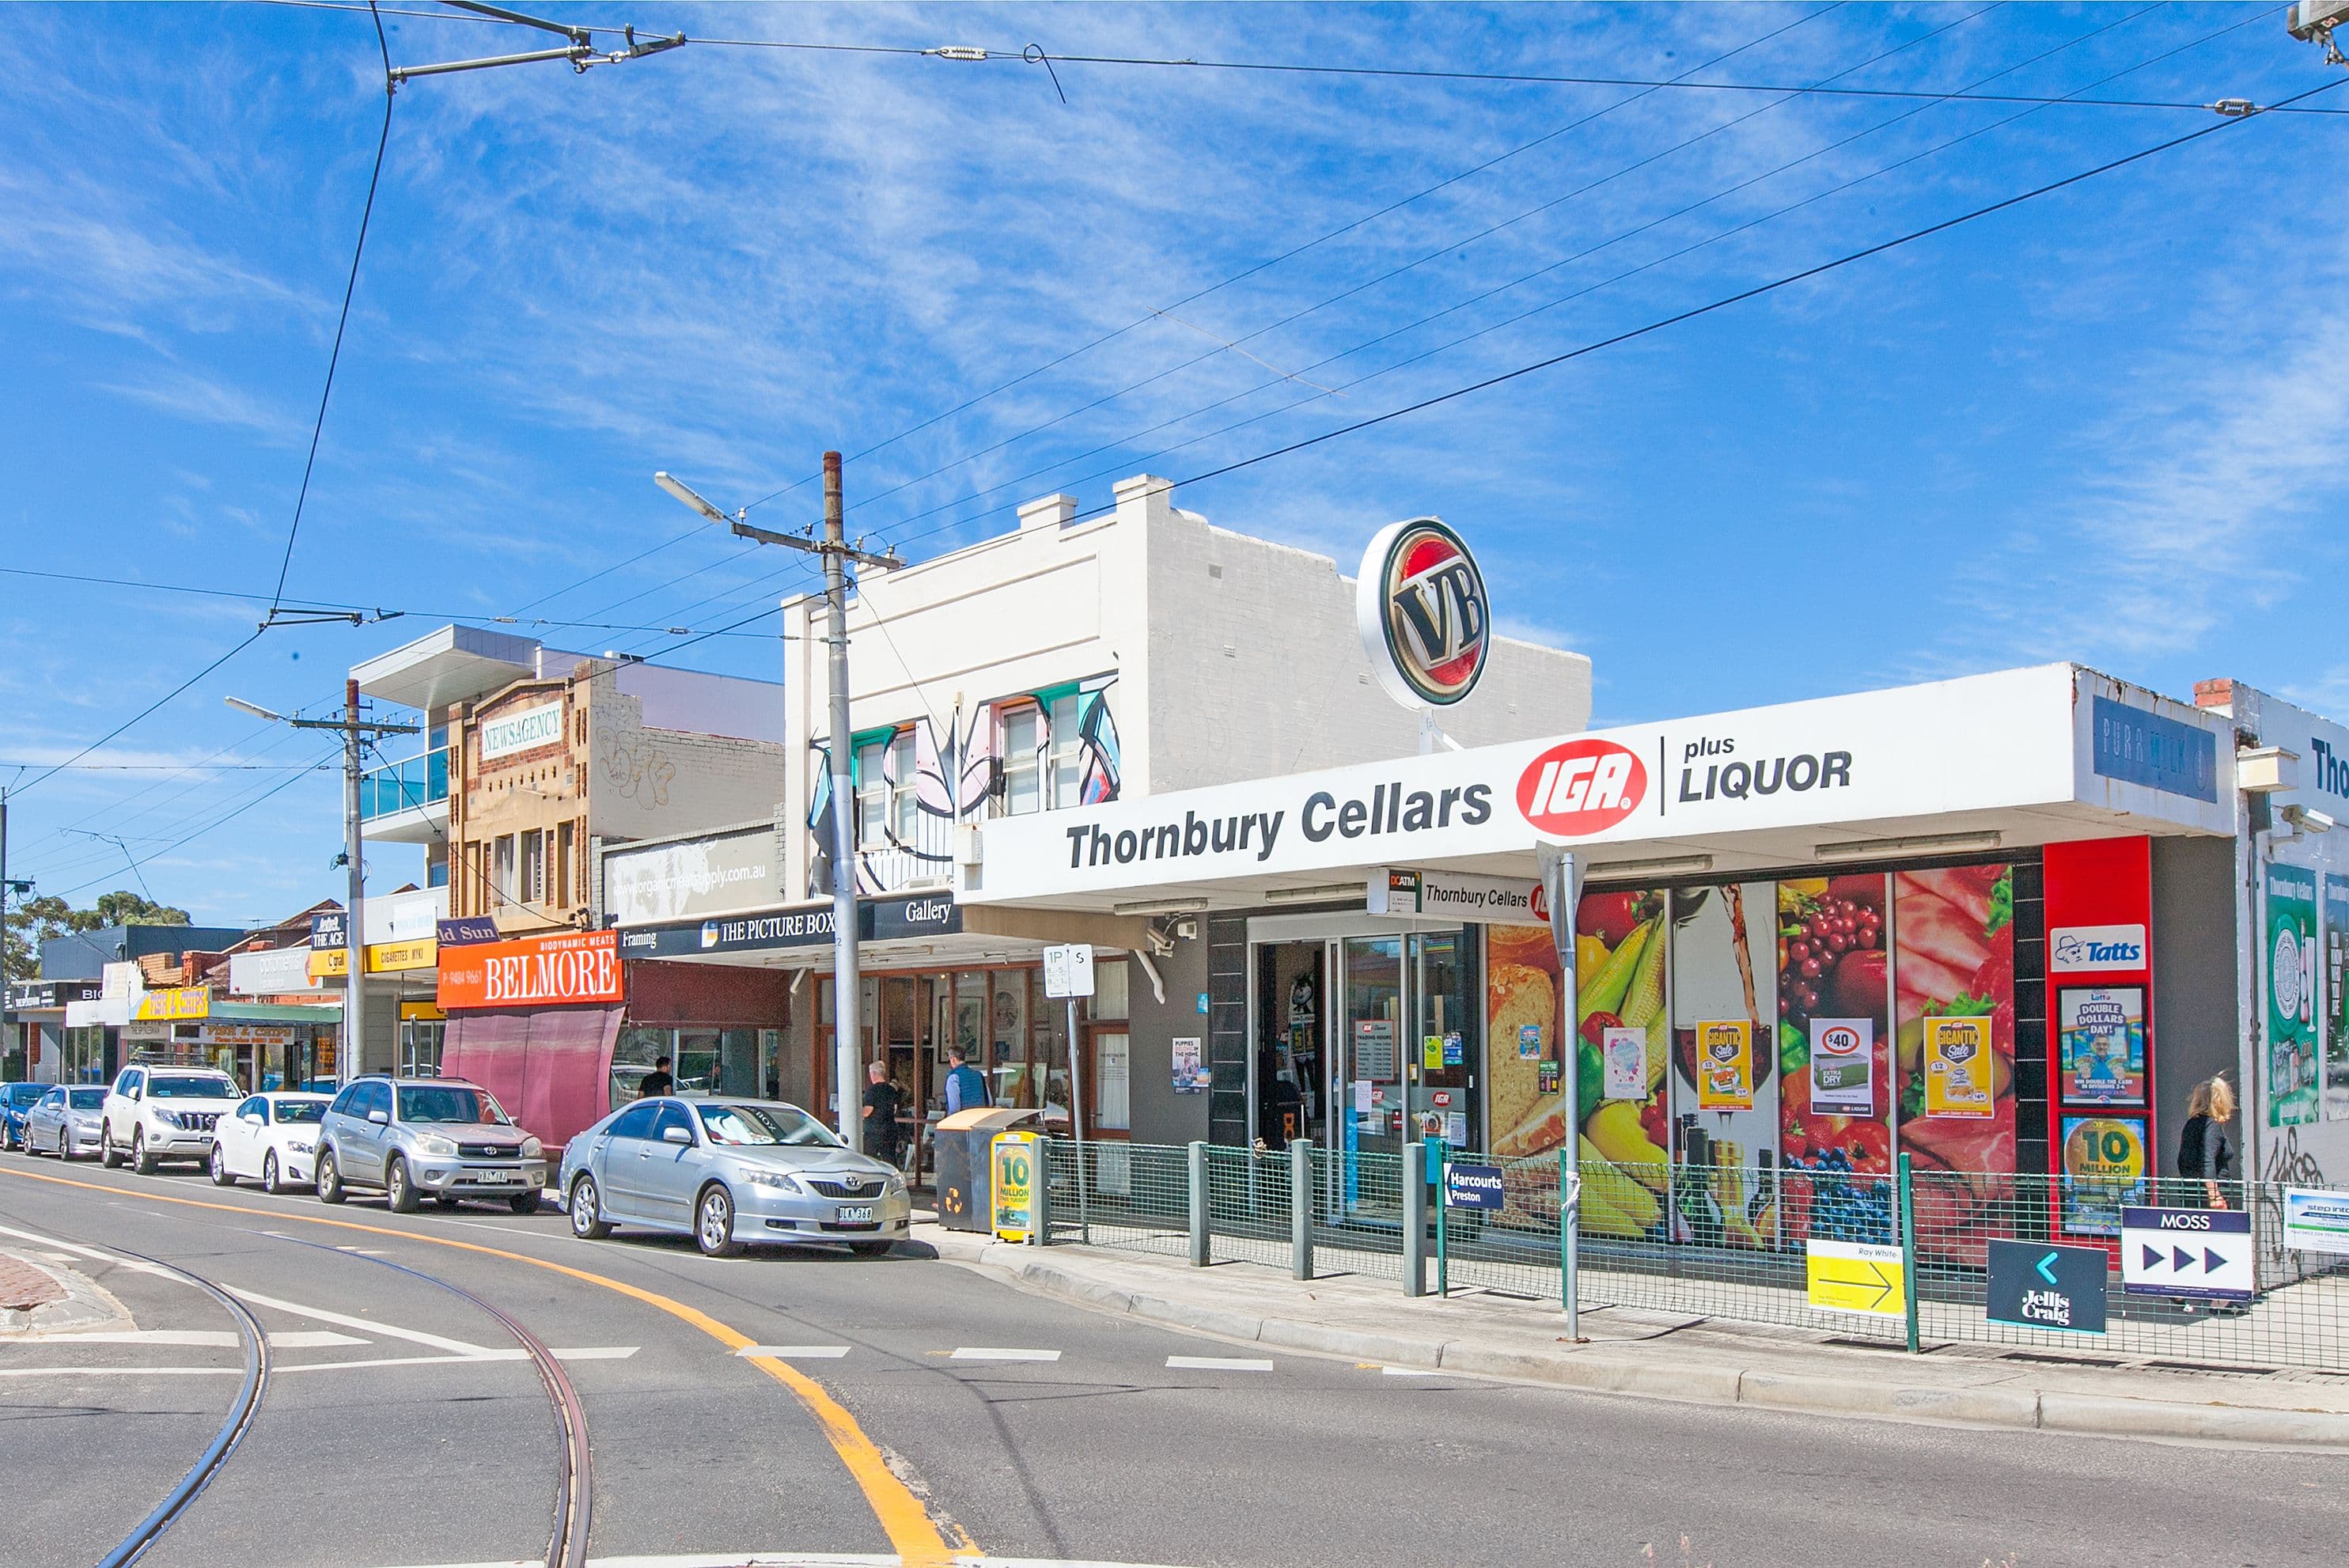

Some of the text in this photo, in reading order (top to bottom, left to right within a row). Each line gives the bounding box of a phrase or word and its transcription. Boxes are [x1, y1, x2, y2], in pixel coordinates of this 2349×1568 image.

[1392, 562, 1483, 664] VB
[484, 709, 561, 753] NEWSAGENCY
[2103, 717, 2144, 763] PURA
[1684, 736, 1735, 763] plus
[1066, 750, 1853, 869] Thornbury Cellars IGA LIQUOR
[1426, 884, 1528, 908] Thornbury Cellars
[2269, 876, 2313, 901] Thornbury Cellars
[905, 900, 952, 924] Gallery
[460, 926, 495, 941] Sun
[722, 911, 835, 943] THE PICTURE BOX
[313, 931, 344, 947] THE AGE
[540, 934, 615, 952] BIODYNAMIC MEATS
[622, 930, 657, 949] Framing
[381, 949, 408, 964] CIGARETTES
[1049, 951, 1063, 964] 1P
[2086, 942, 2140, 963] Tatts
[449, 970, 465, 985] 9484
[466, 969, 482, 985] 9661
[484, 948, 616, 1001] BELMORE
[150, 989, 205, 1016] FISH & CHIPS
[2081, 1004, 2120, 1014] DOUBLE
[2078, 1014, 2124, 1025] DOLLARS
[206, 1027, 292, 1037] FISH & CHIPS
[1938, 1030, 1978, 1045] GIGANTIC
[2089, 1025, 2113, 1034] DAY!
[1708, 1031, 1741, 1045] GIGANTIC
[1828, 1033, 1849, 1047] $40
[1715, 1044, 1733, 1057] Sale
[1947, 1043, 1970, 1058] Sale
[1372, 1091, 1383, 1100] GA
[1434, 1094, 1449, 1104] IGA
[2082, 1131, 2131, 1164] 10
[1002, 1156, 1029, 1187] 10
[2079, 1163, 2131, 1174] MILLION
[1450, 1172, 1502, 1190] Harcourts
[999, 1187, 1029, 1197] MILLION
[1451, 1189, 1481, 1203] Preston
[2307, 1204, 2332, 1213] step
[2161, 1214, 2211, 1230] MOSS
[1858, 1248, 1897, 1259] Ray White
[2021, 1290, 2070, 1308] Jellis
[2021, 1303, 2070, 1326] Craig
